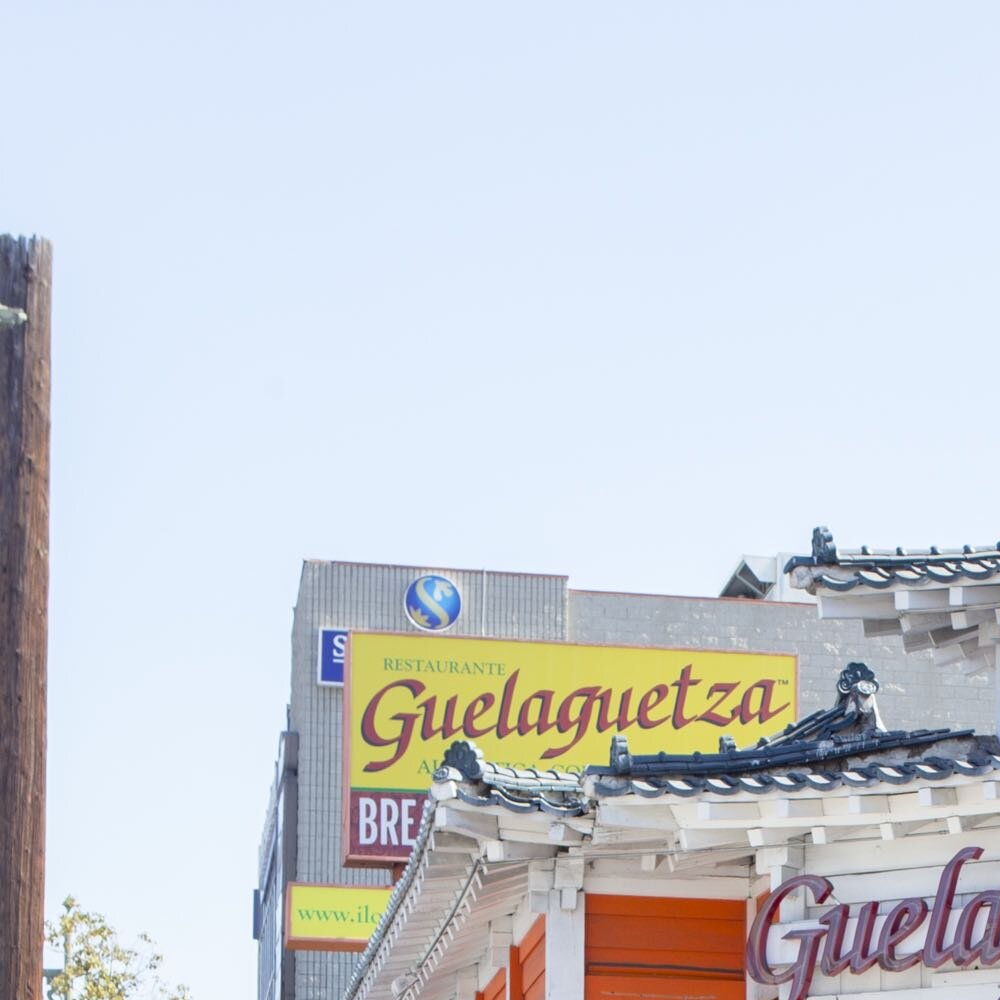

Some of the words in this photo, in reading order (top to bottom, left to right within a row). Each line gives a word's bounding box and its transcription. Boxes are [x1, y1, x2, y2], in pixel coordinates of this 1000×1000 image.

[383, 657, 506, 676] RESTAURANTE
[361, 664, 790, 773] Guelaguetza
[359, 797, 419, 847] BRE
[298, 904, 383, 924] www.ilo
